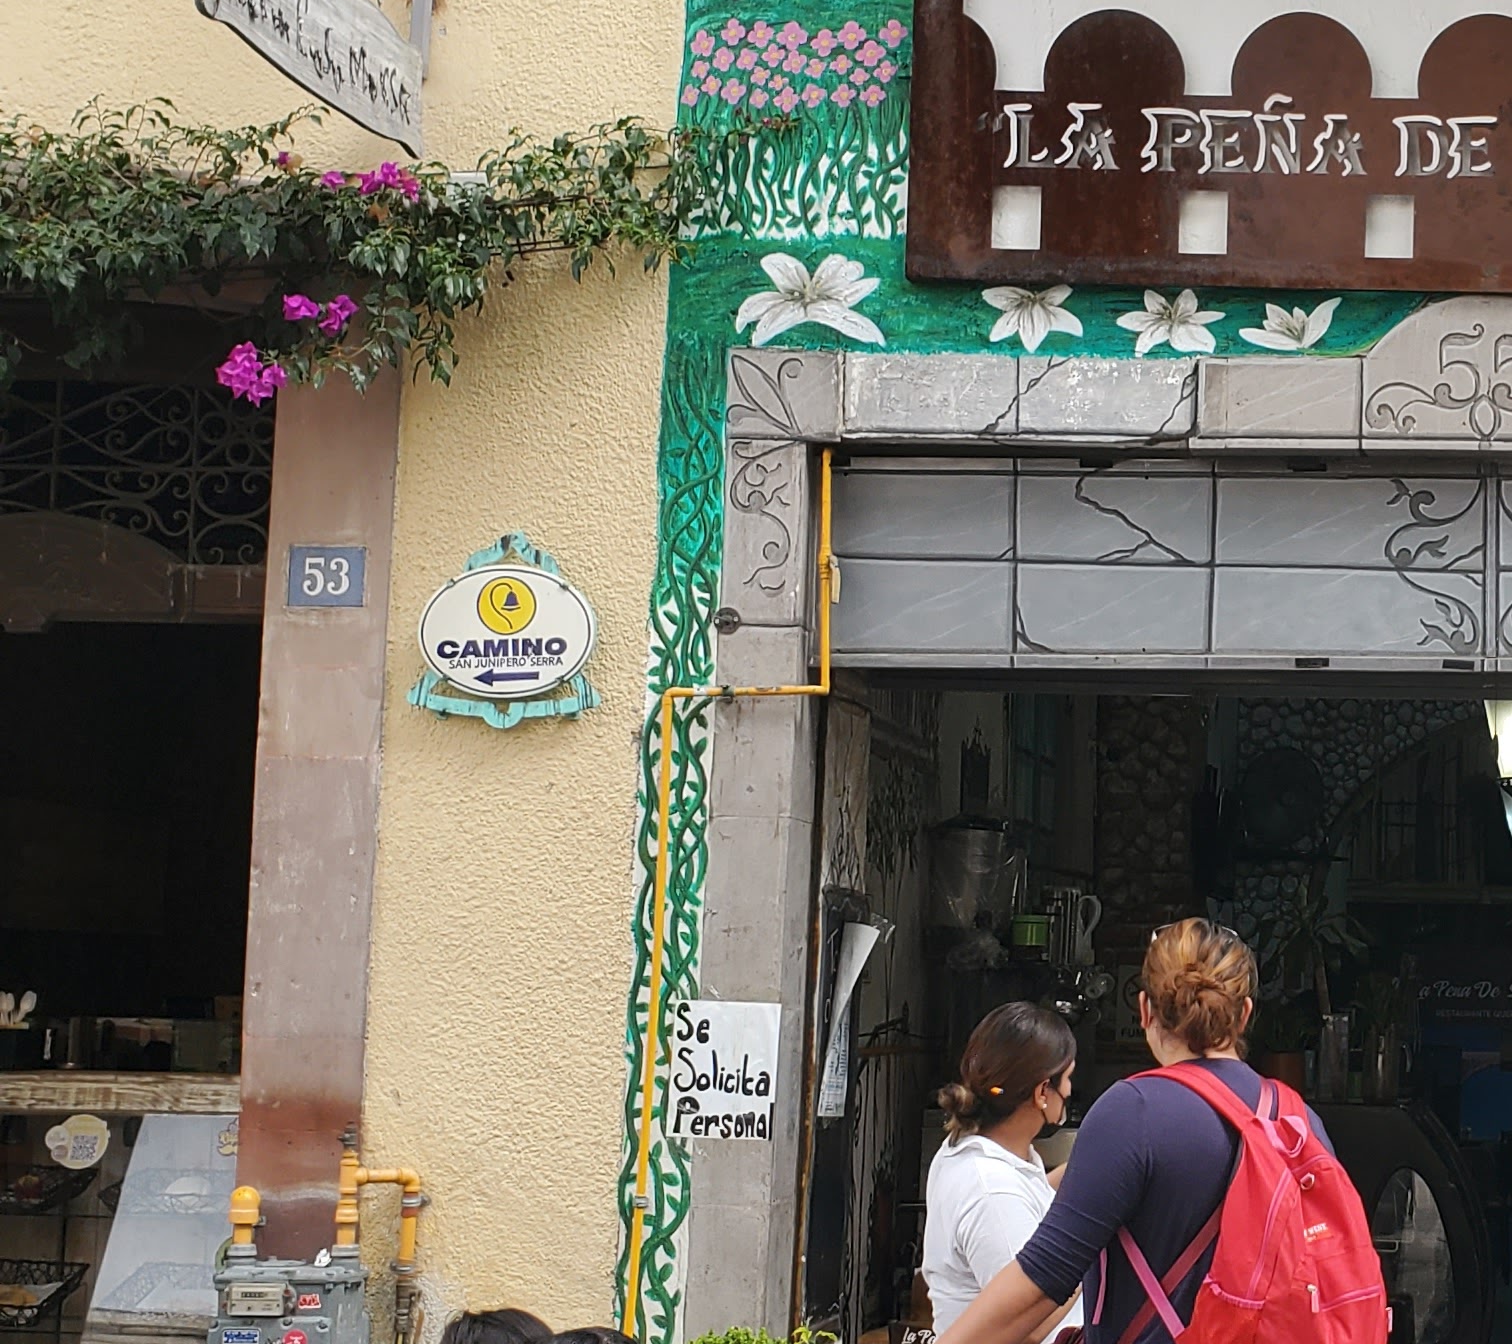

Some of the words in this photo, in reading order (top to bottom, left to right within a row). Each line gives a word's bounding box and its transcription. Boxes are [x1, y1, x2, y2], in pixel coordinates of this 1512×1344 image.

[1140, 94, 1366, 177] PEÑA
[1393, 114, 1498, 178] DE
[302, 557, 350, 596] 53
[436, 637, 568, 659] CAMINO
[449, 657, 472, 669] SAN
[474, 657, 527, 668] JUNIPERO
[529, 656, 564, 666] SERRA
[676, 1002, 710, 1044] Se
[673, 1047, 771, 1097] Solicita
[673, 1096, 775, 1141] Personal
[901, 1326, 917, 1344] La
